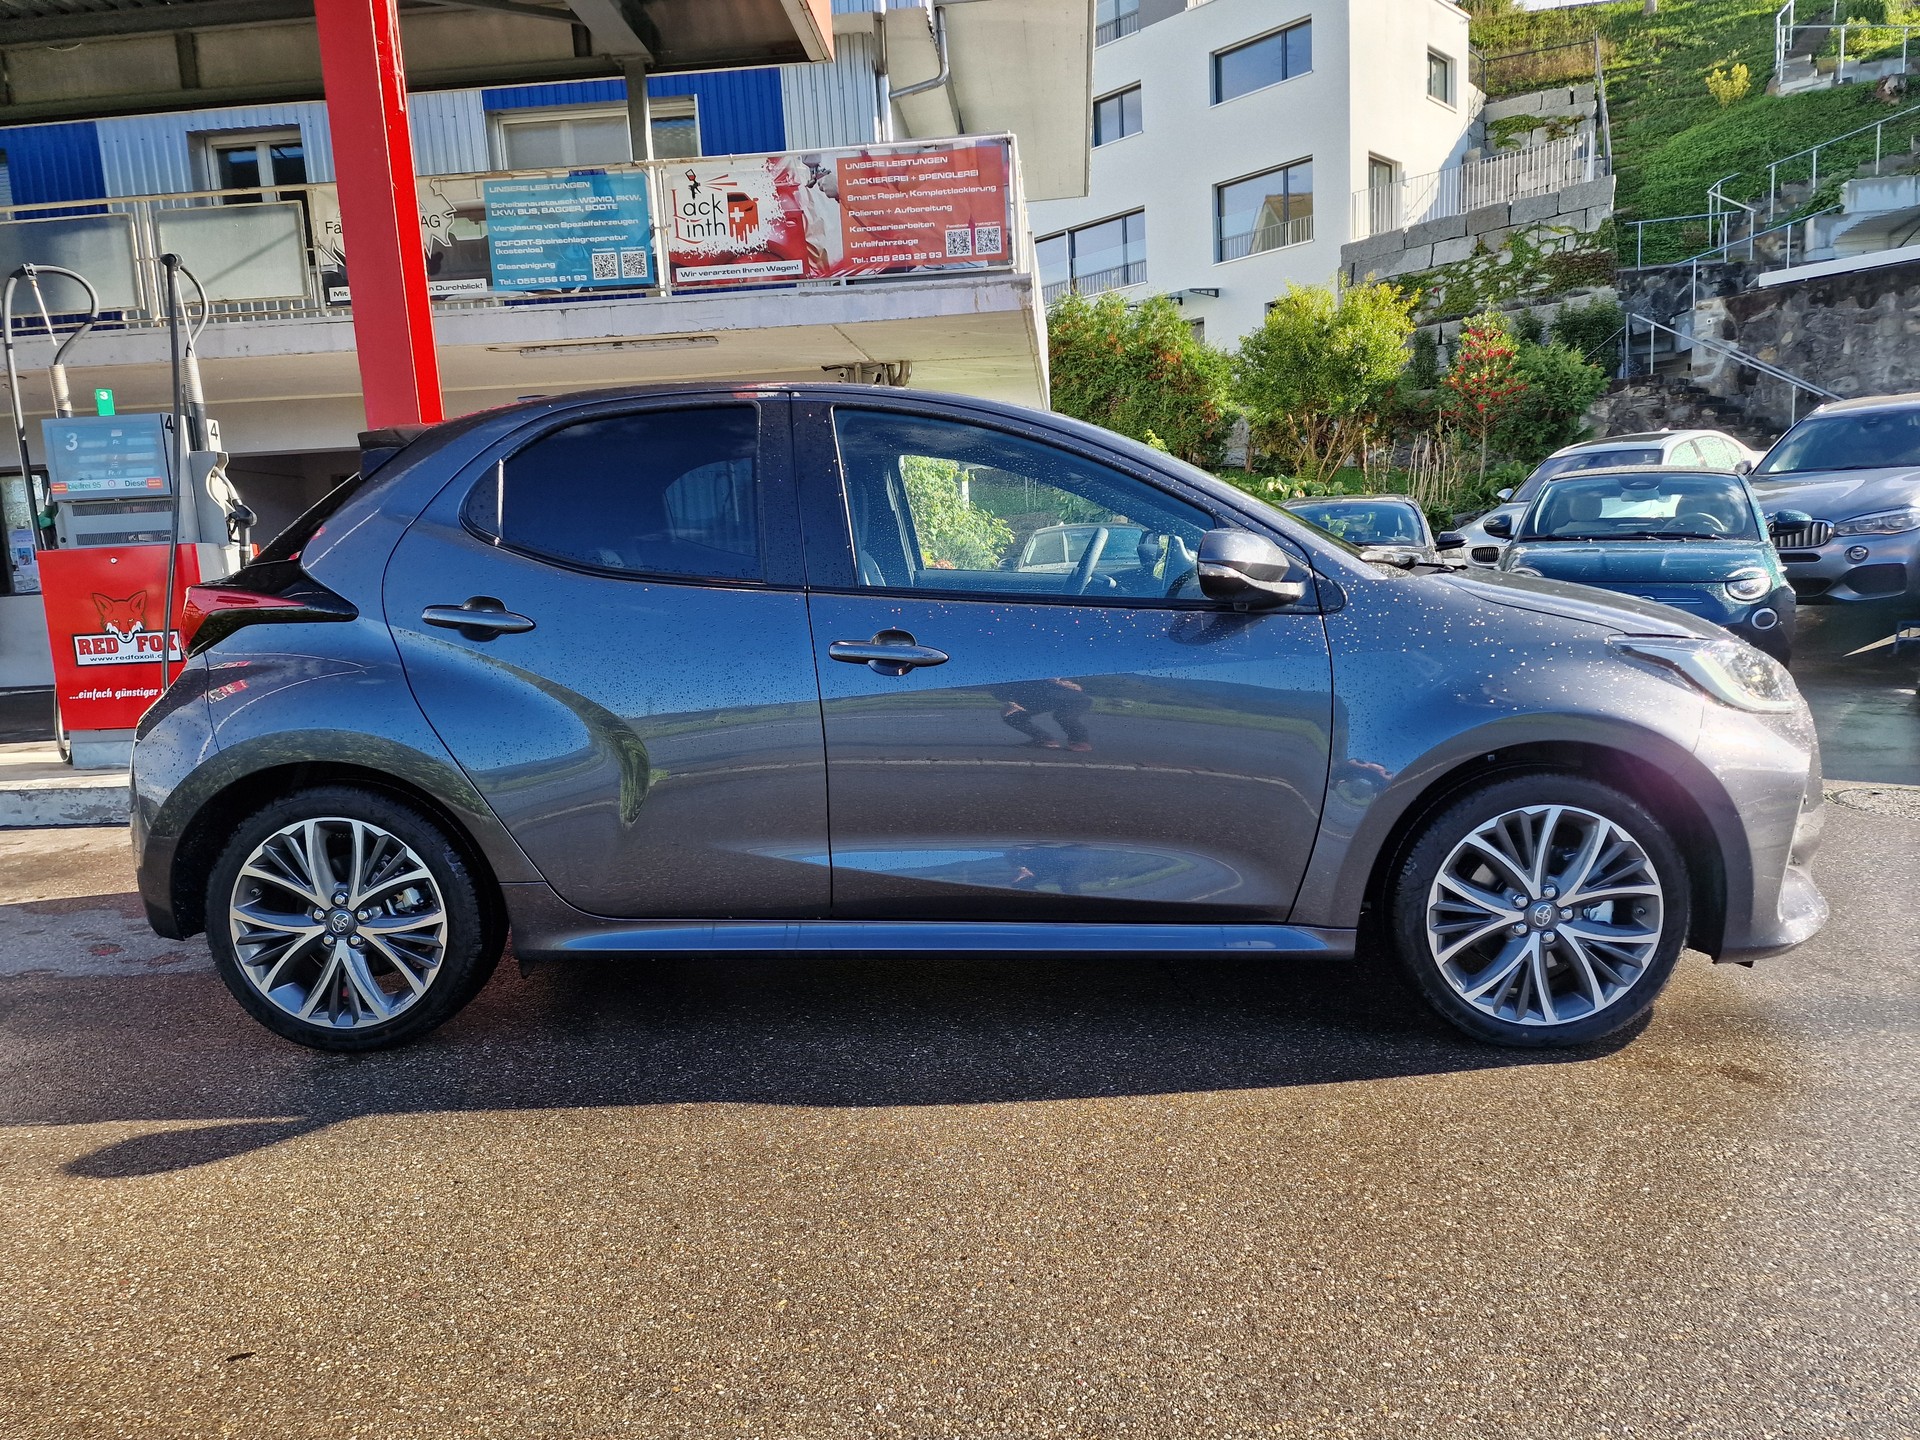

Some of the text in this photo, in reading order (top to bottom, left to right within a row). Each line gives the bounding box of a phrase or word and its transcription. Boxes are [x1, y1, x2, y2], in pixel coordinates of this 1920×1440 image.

[845, 156, 948, 170] UNSERE LEISTUNGEN
[846, 175, 909, 186] LACKIEREREI
[918, 169, 979, 181] SPENGLEREI
[489, 182, 590, 193] UNSERE LEISTUNGEN
[847, 184, 997, 202] Smart Repair, Komplettlackierung
[490, 194, 642, 208] Scheibenaustausch: WOMO, PKW,
[491, 203, 618, 217] LKW, BUS, BAGGER, BOOTE
[848, 208, 885, 217] Polieren
[894, 204, 953, 215] Aufbereitung
[493, 218, 639, 233] Verglasung von Spezialfahrzeugen
[849, 221, 935, 233] Karosseriearbeiten
[850, 239, 919, 249] Unfallfahrzeuge
[495, 246, 544, 256] (kostenlos)
[869, 255, 891, 263] 055
[891, 253, 912, 261] 283
[928, 251, 942, 259] 93
[496, 262, 556, 271] Glasreinigung
[680, 264, 799, 278] Wir verarzten Ihren Wagen!
[516, 277, 537, 285] 055
[333, 290, 348, 298] Mit
[435, 282, 483, 291] Durchblick!
[99, 391, 109, 400] 3
[165, 414, 174, 434] 4
[210, 422, 219, 440] 4
[65, 432, 78, 451] 3
[124, 479, 147, 487] Diesel
[78, 639, 119, 655] RED
[90, 654, 163, 662] www.redfoxoil.c
[69, 688, 112, 700] ...einfach
[115, 687, 158, 699] günstiger
